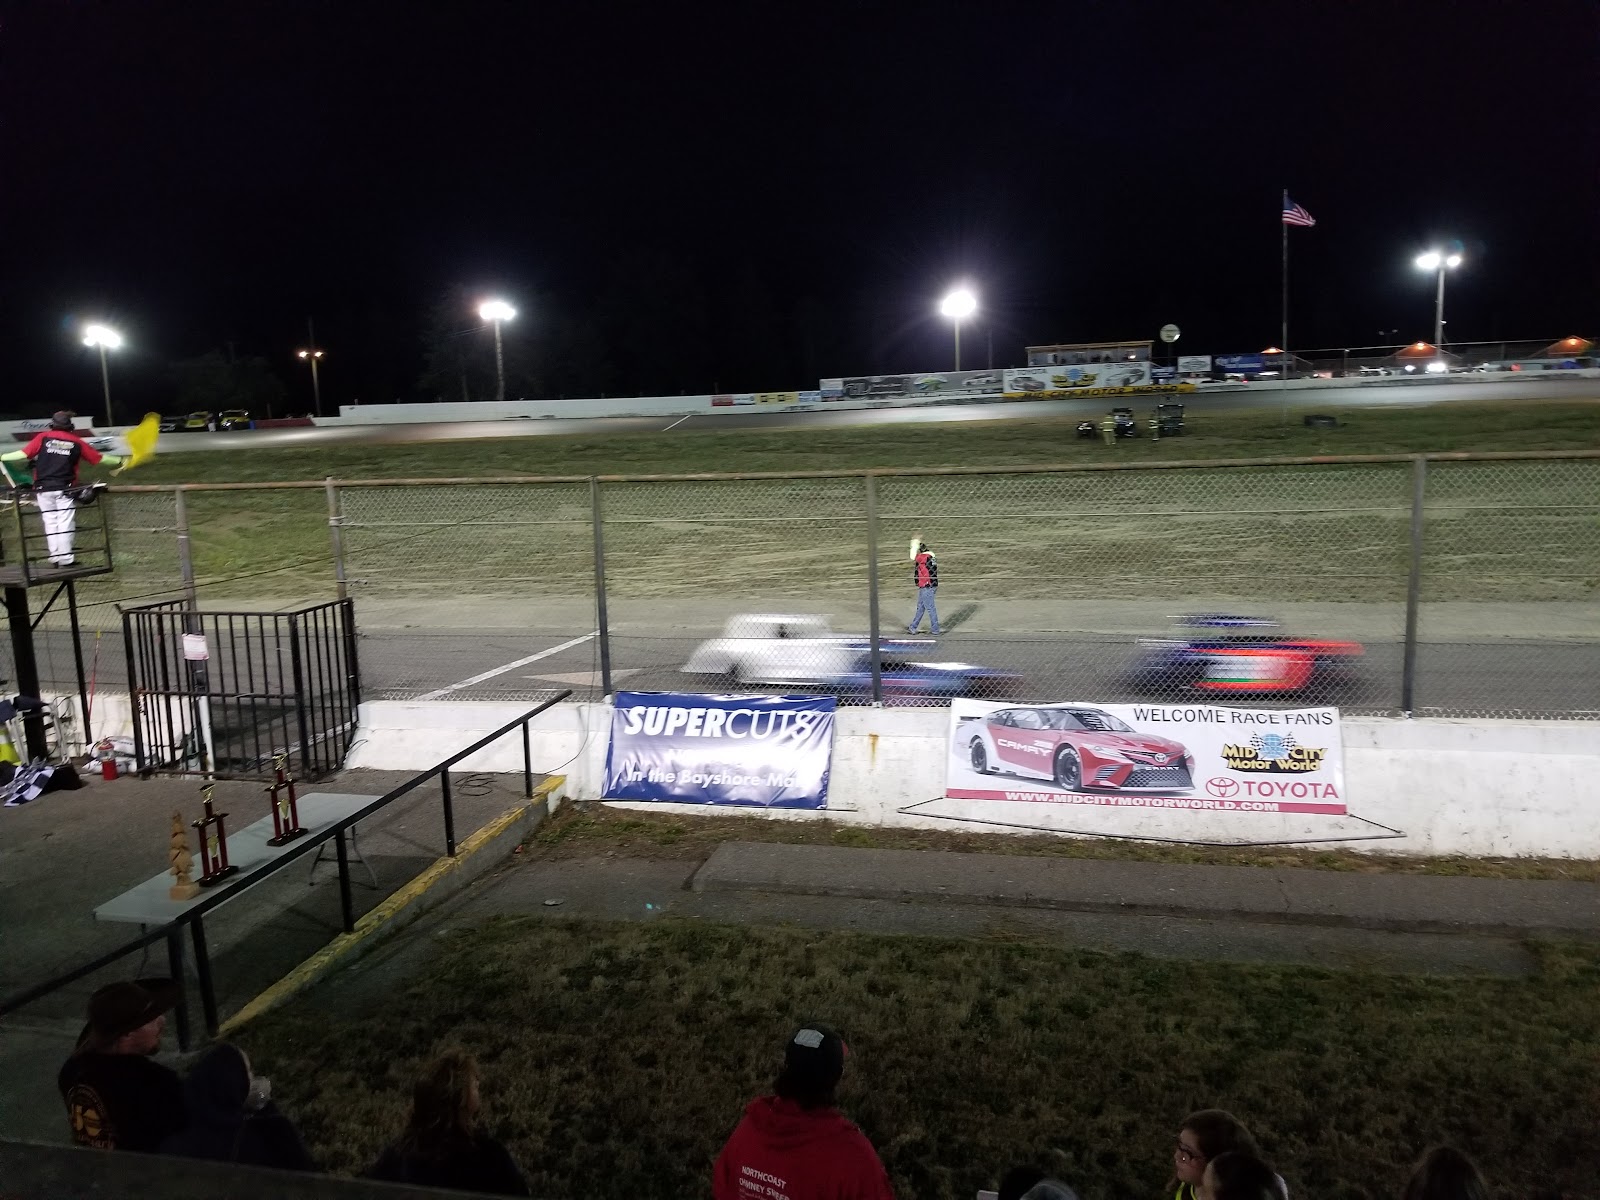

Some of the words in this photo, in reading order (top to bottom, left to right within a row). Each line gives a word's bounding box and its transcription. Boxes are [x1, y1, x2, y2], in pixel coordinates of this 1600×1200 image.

[1080, 387, 1125, 395] MOTOR
[624, 705, 813, 741] SUPERCUTS
[1134, 708, 1226, 723] WELCOME
[1231, 711, 1280, 725] RACE
[1285, 712, 1334, 725] FANS
[1221, 743, 1257, 759] MID
[1290, 746, 1329, 760] CITY
[1226, 758, 1272, 770] Motor
[1275, 758, 1321, 771] World
[627, 768, 643, 782] In
[647, 769, 676, 783] the
[680, 770, 761, 788] Bayshore
[1243, 781, 1339, 799] TOYOTA
[1005, 791, 1280, 812] WWW.MIDCITYMOTORWORLD.COM
[742, 1166, 787, 1189] NORTHCOAST
